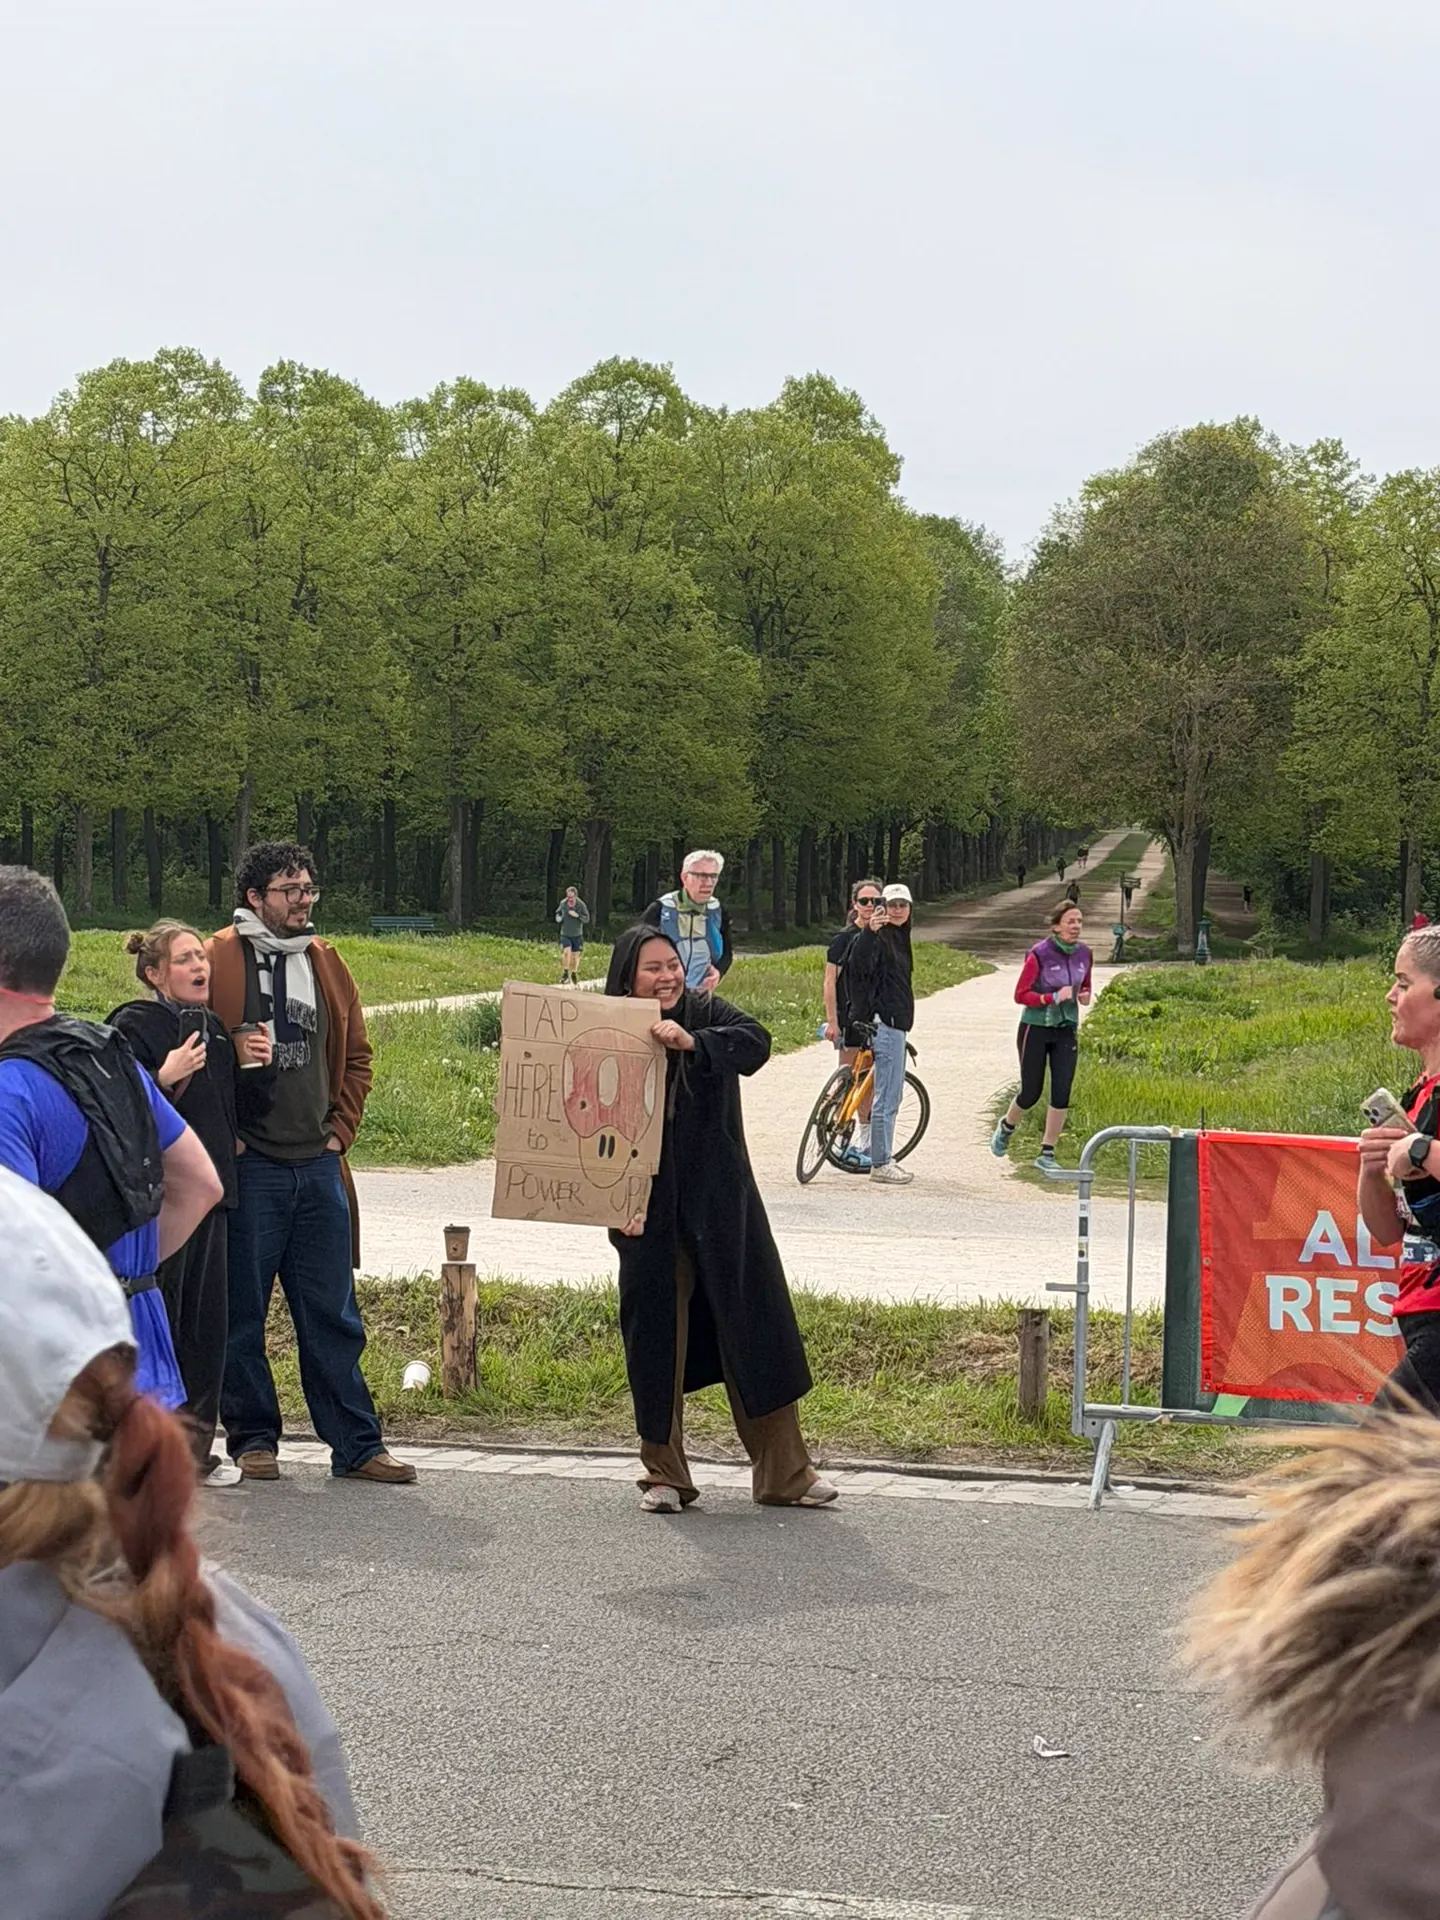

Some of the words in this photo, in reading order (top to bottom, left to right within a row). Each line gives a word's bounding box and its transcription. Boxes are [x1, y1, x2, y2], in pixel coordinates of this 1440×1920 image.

[512, 991, 579, 1039] TAP
[504, 1060, 561, 1123] HERE
[527, 1128, 549, 1150] to
[505, 1164, 585, 1211] POWER
[1298, 1210, 1402, 1269] AL
[1265, 1275, 1400, 1337] RES
